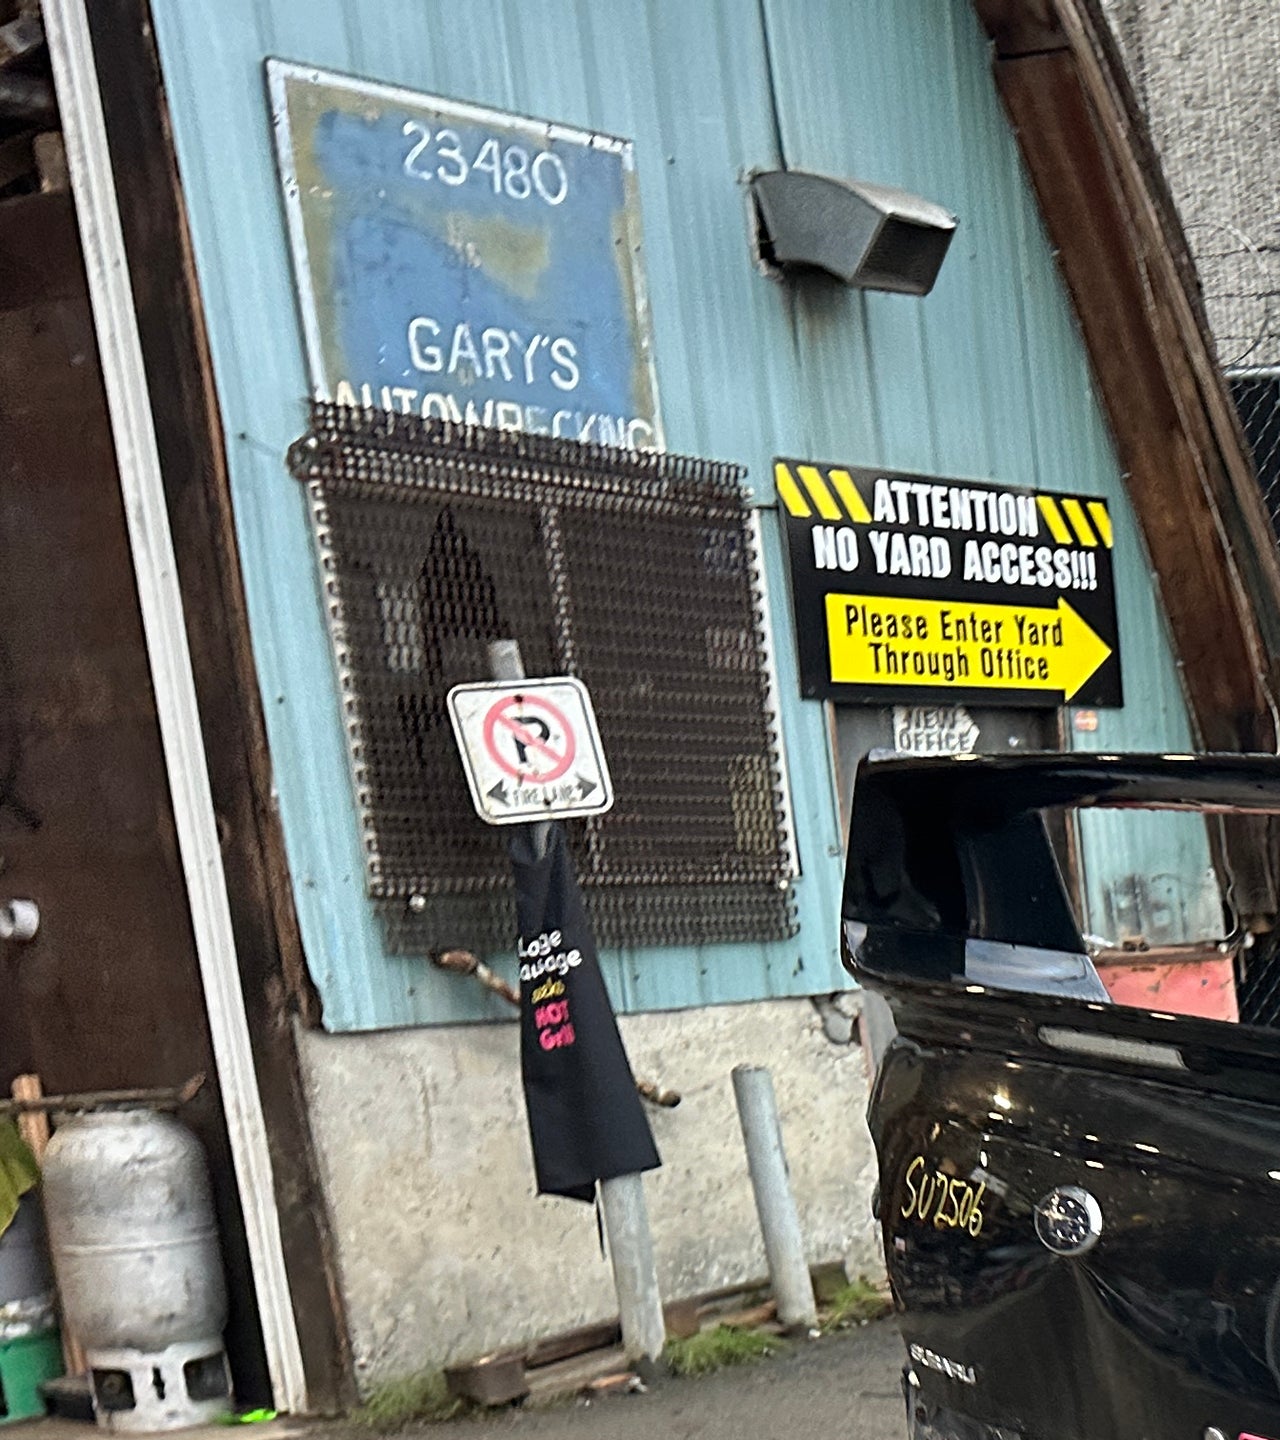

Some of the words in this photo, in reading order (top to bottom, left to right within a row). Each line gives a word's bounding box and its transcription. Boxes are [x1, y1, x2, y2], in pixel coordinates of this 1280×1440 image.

[403, 120, 568, 205] 23480
[407, 316, 579, 391] GARY'S
[873, 478, 1039, 538] ATTENTION
[811, 524, 859, 572] NO
[868, 530, 952, 579] YARD
[963, 540, 1098, 591] ACCESS!!!
[845, 604, 928, 640] Please
[940, 609, 1003, 644] Enter
[1013, 614, 1064, 648] Yard
[868, 642, 969, 682] Through
[980, 648, 1049, 681] Office
[898, 727, 972, 751] OFFICE
[901, 1156, 985, 1237] SU2506
